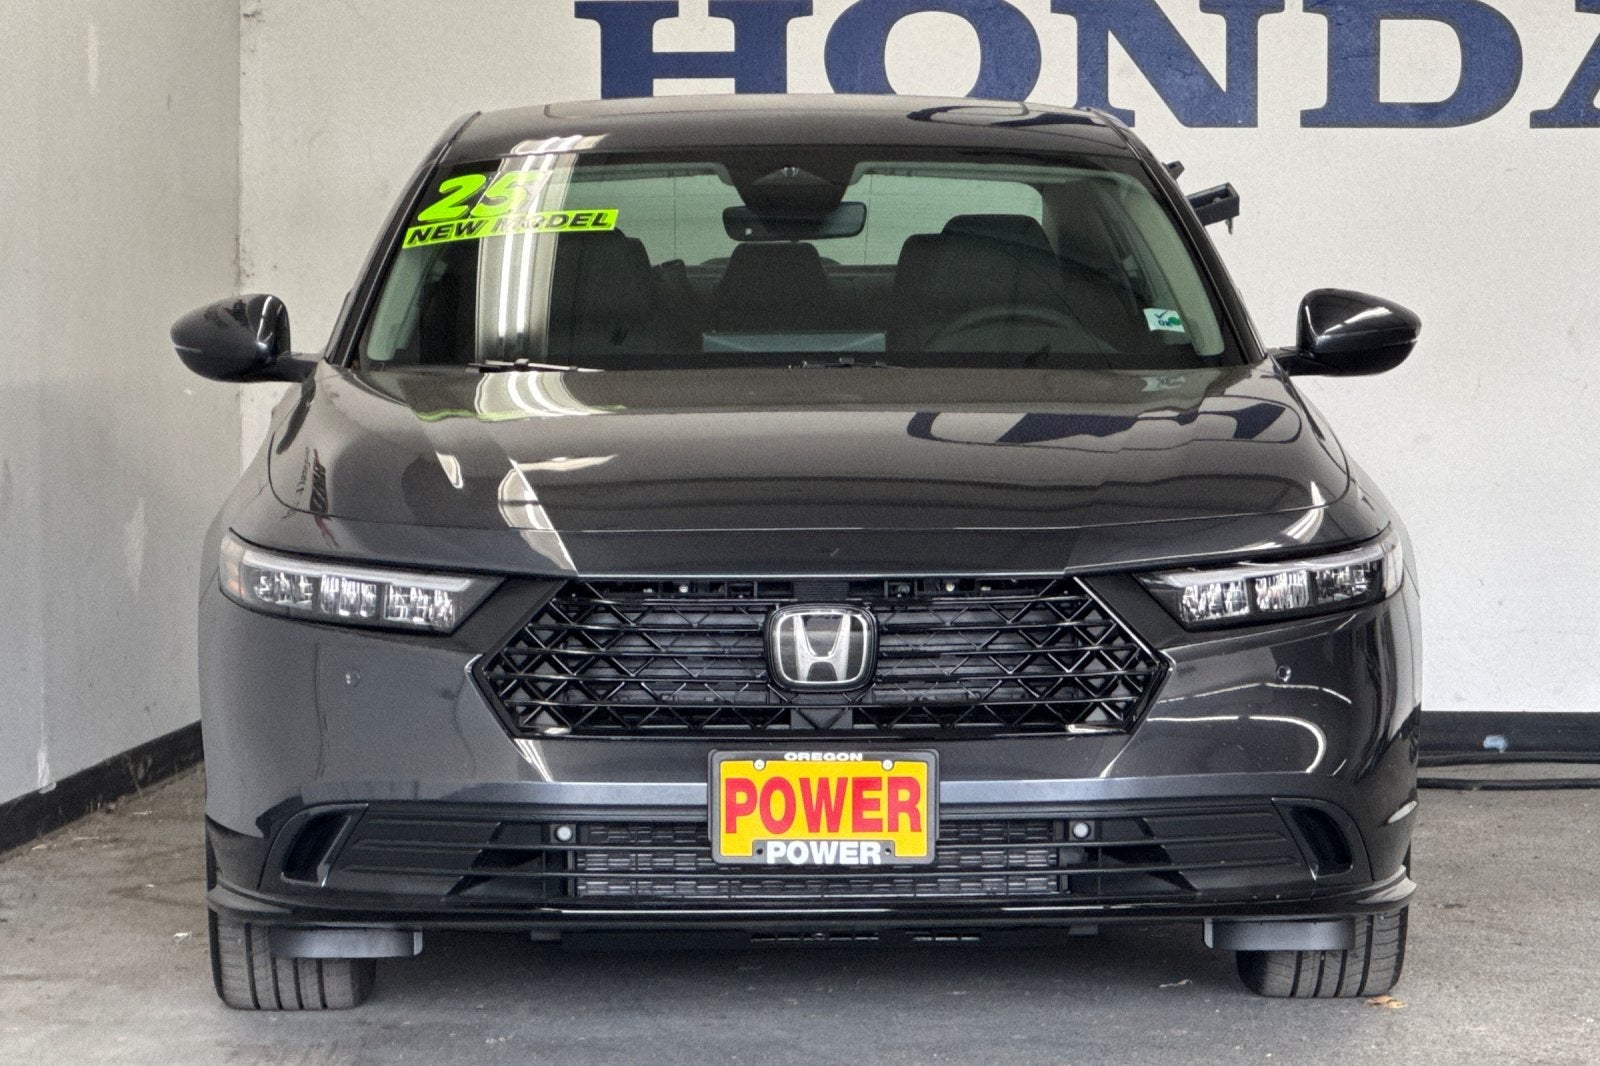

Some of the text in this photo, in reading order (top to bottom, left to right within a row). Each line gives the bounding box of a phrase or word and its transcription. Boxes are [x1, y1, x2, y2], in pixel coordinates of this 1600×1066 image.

[418, 171, 541, 221] 25
[407, 220, 487, 244] NEW
[783, 752, 863, 762] OREGON
[725, 776, 922, 835] POWER
[766, 841, 882, 864] POWER
